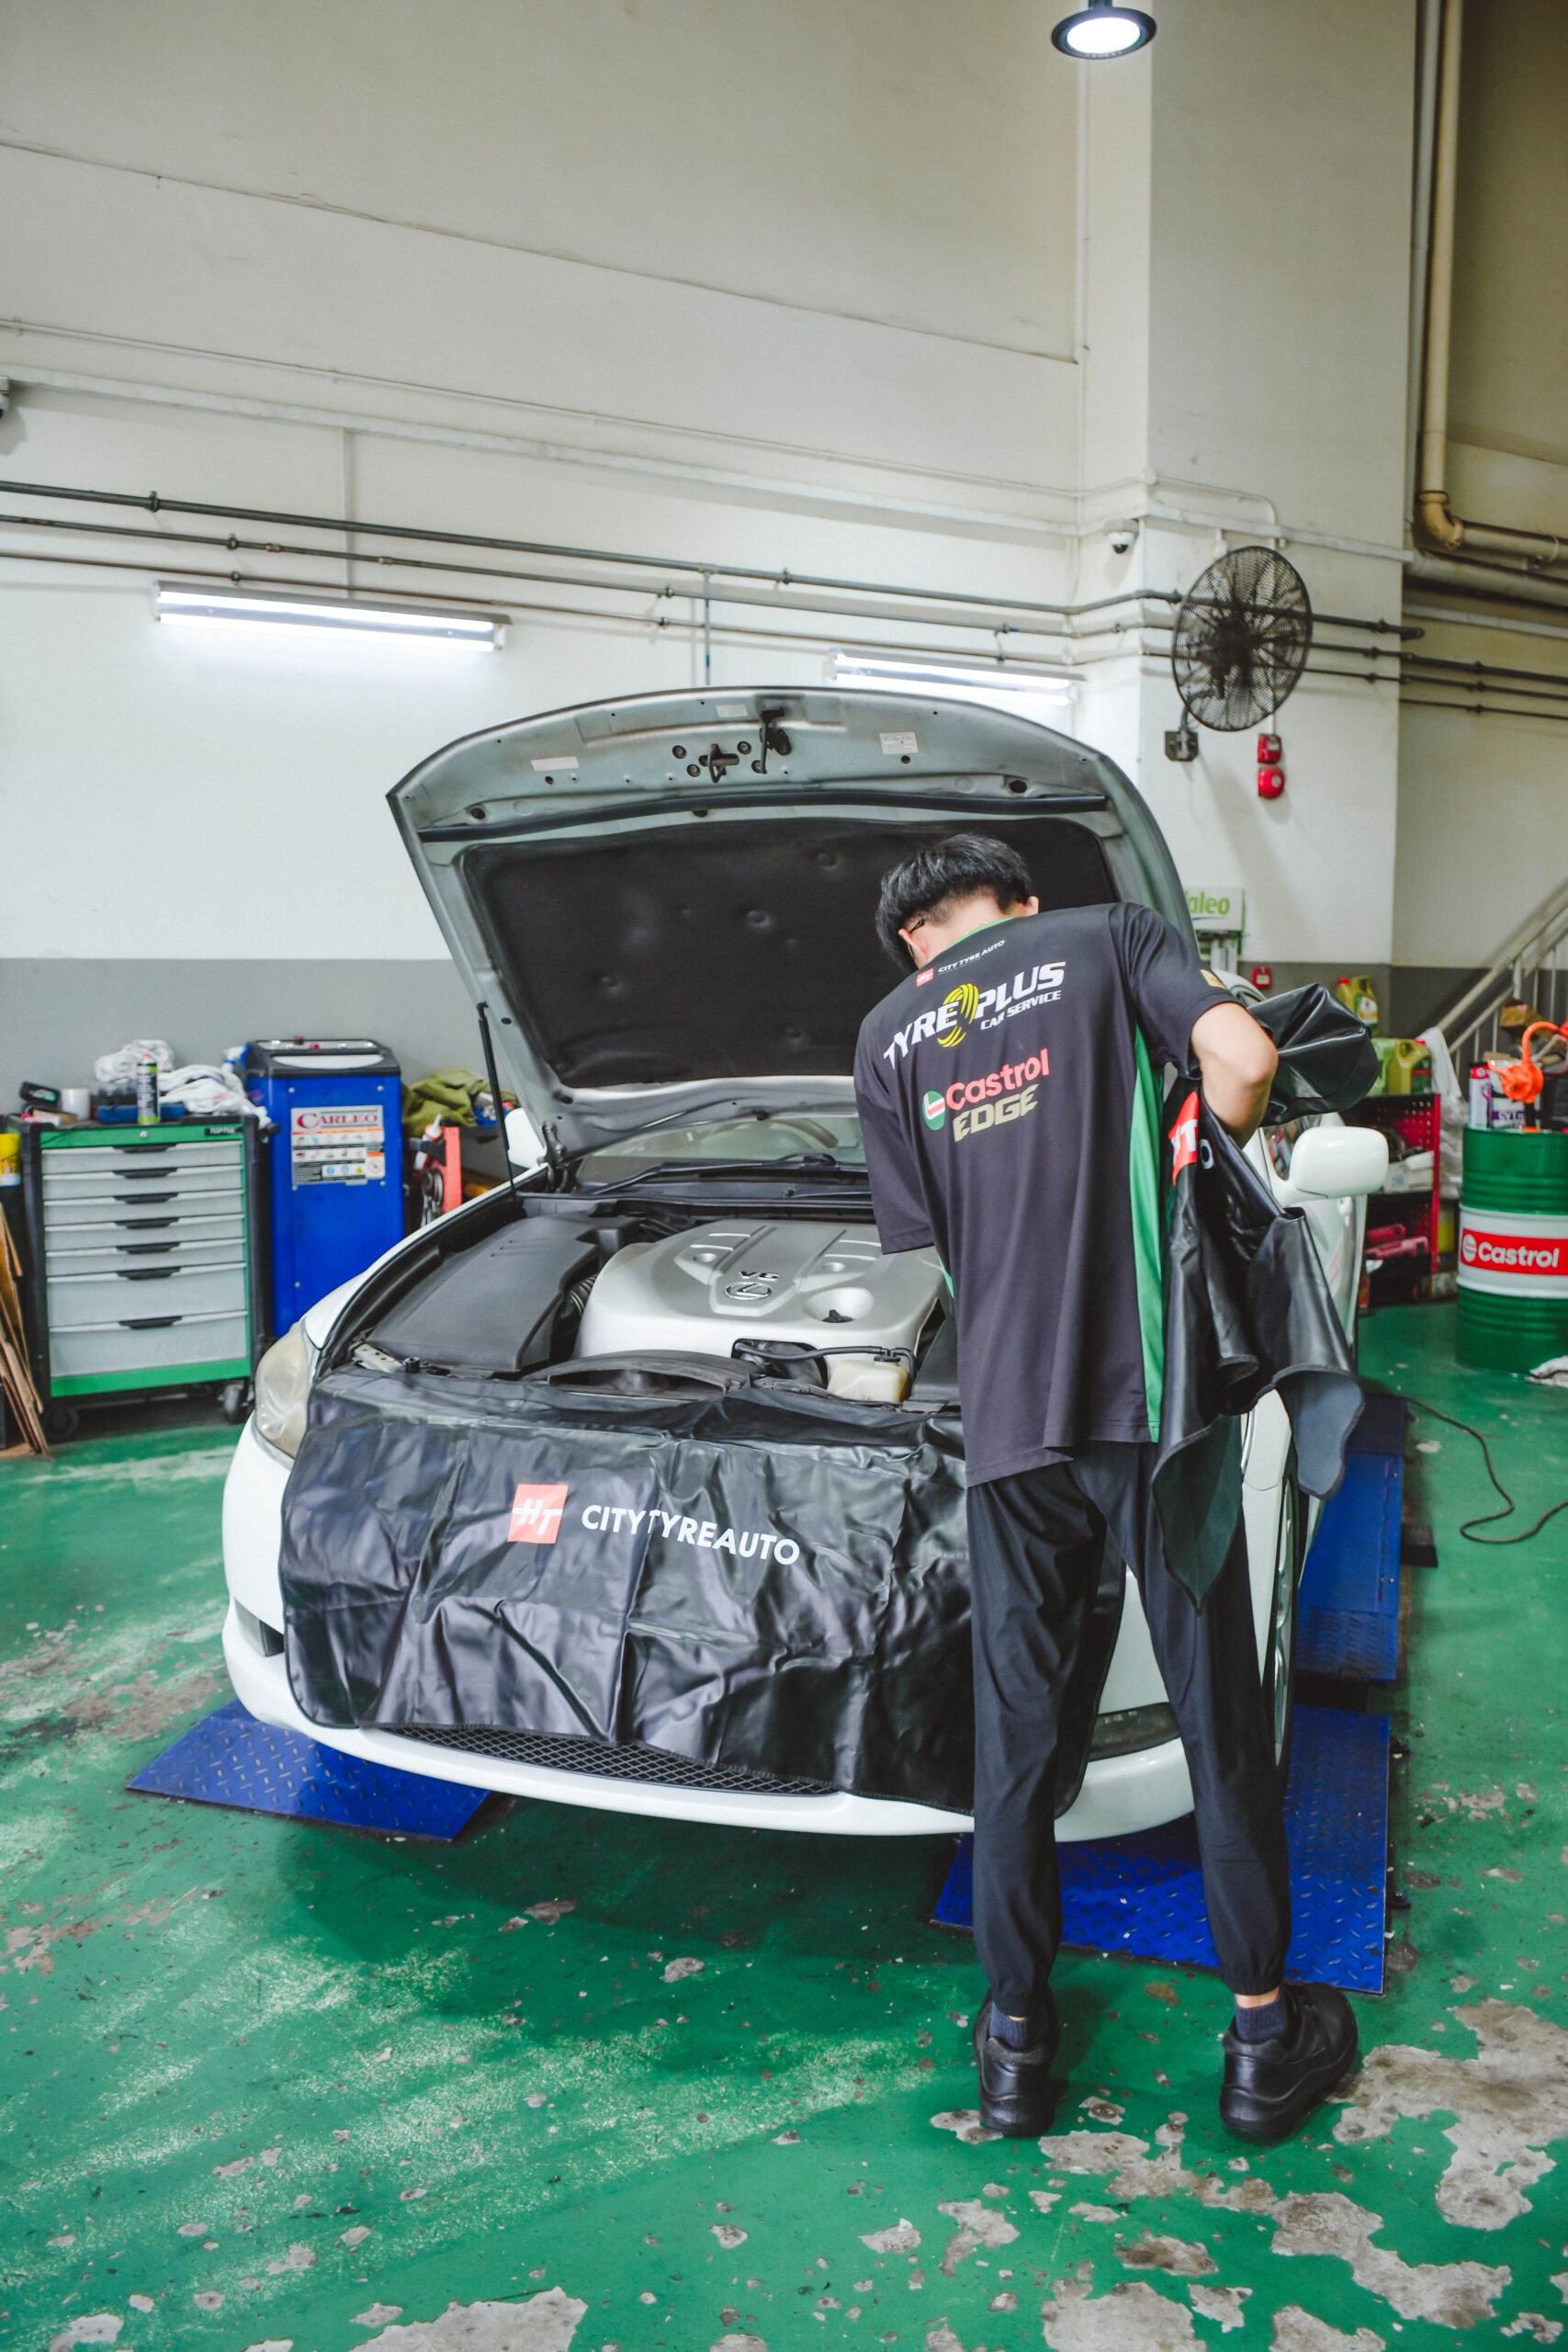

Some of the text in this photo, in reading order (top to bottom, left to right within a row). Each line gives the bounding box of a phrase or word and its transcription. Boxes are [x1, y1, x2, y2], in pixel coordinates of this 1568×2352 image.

[1184, 890, 1230, 915] aleo
[938, 940, 1006, 973] CITY TYRE AUTO
[884, 962, 1066, 1069] TYRE PLUS
[981, 989, 1062, 1030] CAR SERVICE
[946, 1047, 1050, 1111] Castrol
[297, 1112, 378, 1129] CARLEO
[953, 1083, 1040, 1143] EDGE
[1478, 1241, 1560, 1268] Castrol
[739, 1271, 780, 1282] V6
[512, 1498, 564, 1535] HT
